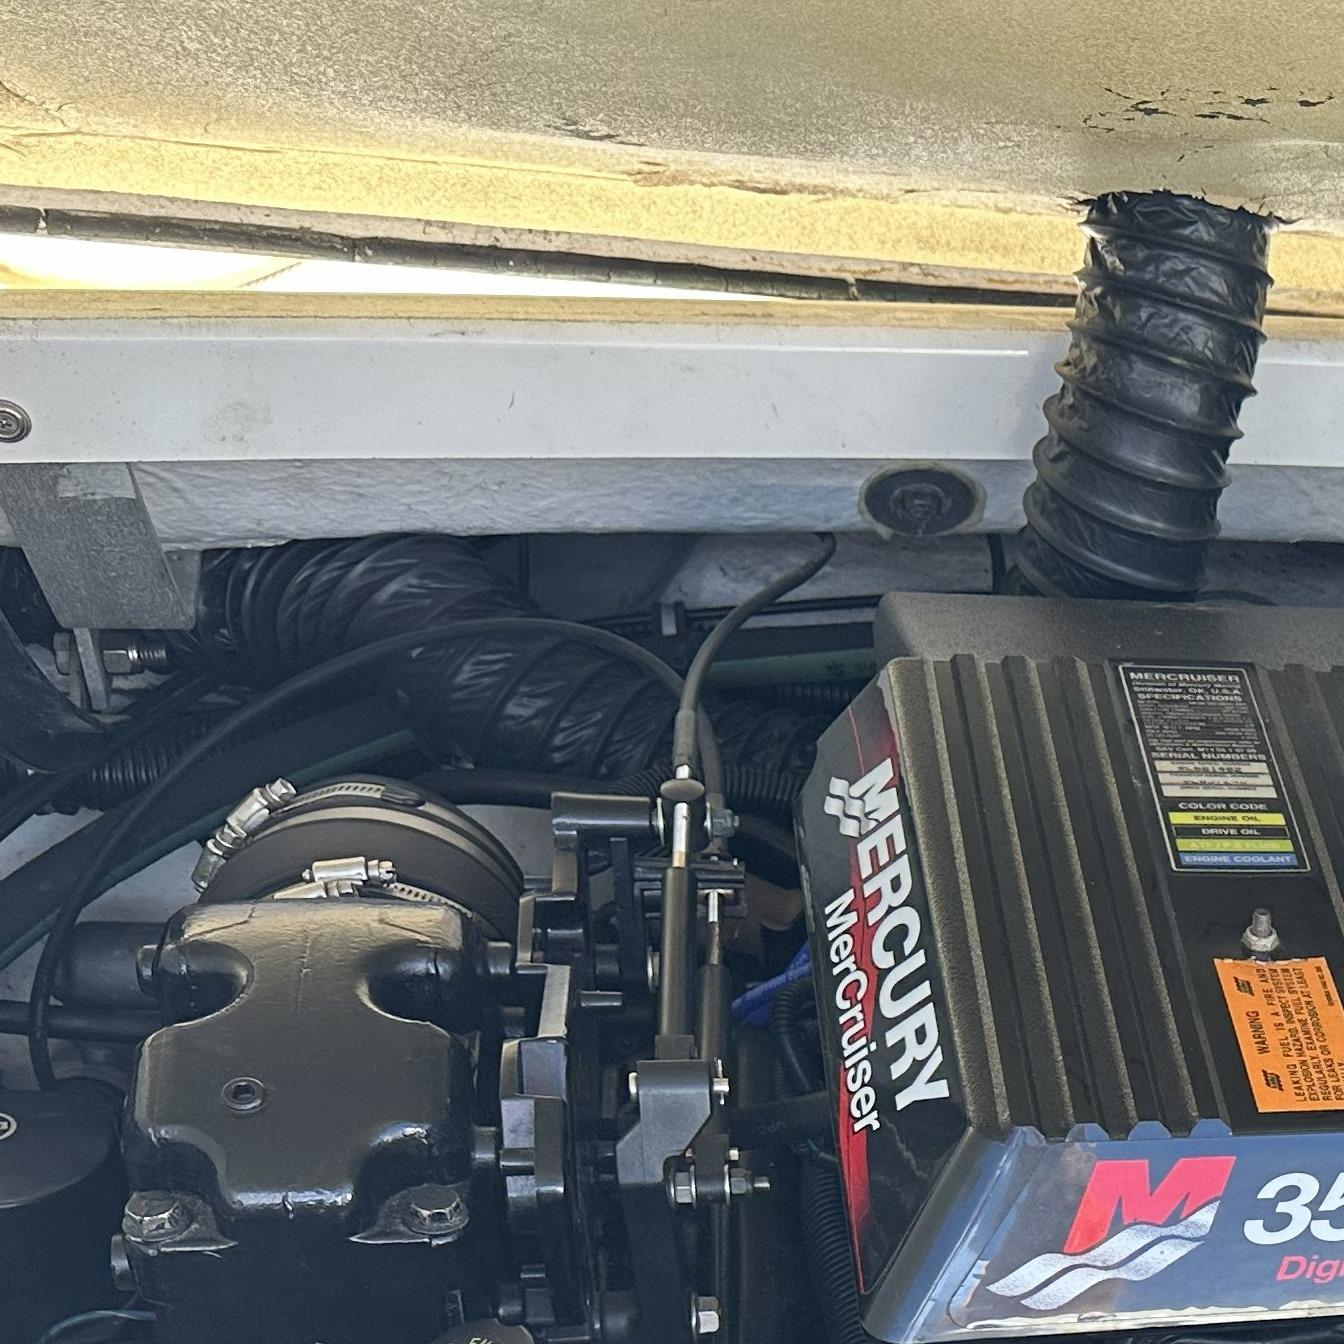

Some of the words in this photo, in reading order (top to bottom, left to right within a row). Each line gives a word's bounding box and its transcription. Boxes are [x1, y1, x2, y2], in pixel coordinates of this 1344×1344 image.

[1129, 672, 1240, 682] MERCRUISER
[849, 757, 950, 1112] MERCURY
[1255, 968, 1270, 983] AND
[1261, 988, 1277, 1005] FIRE
[823, 888, 883, 1133] MerCruiser
[1243, 1010, 1271, 1054] WARNING
[1272, 1022, 1285, 1030] IS
[1276, 1036, 1293, 1057] FUEL
[1285, 1063, 1307, 1102] LEAKING
